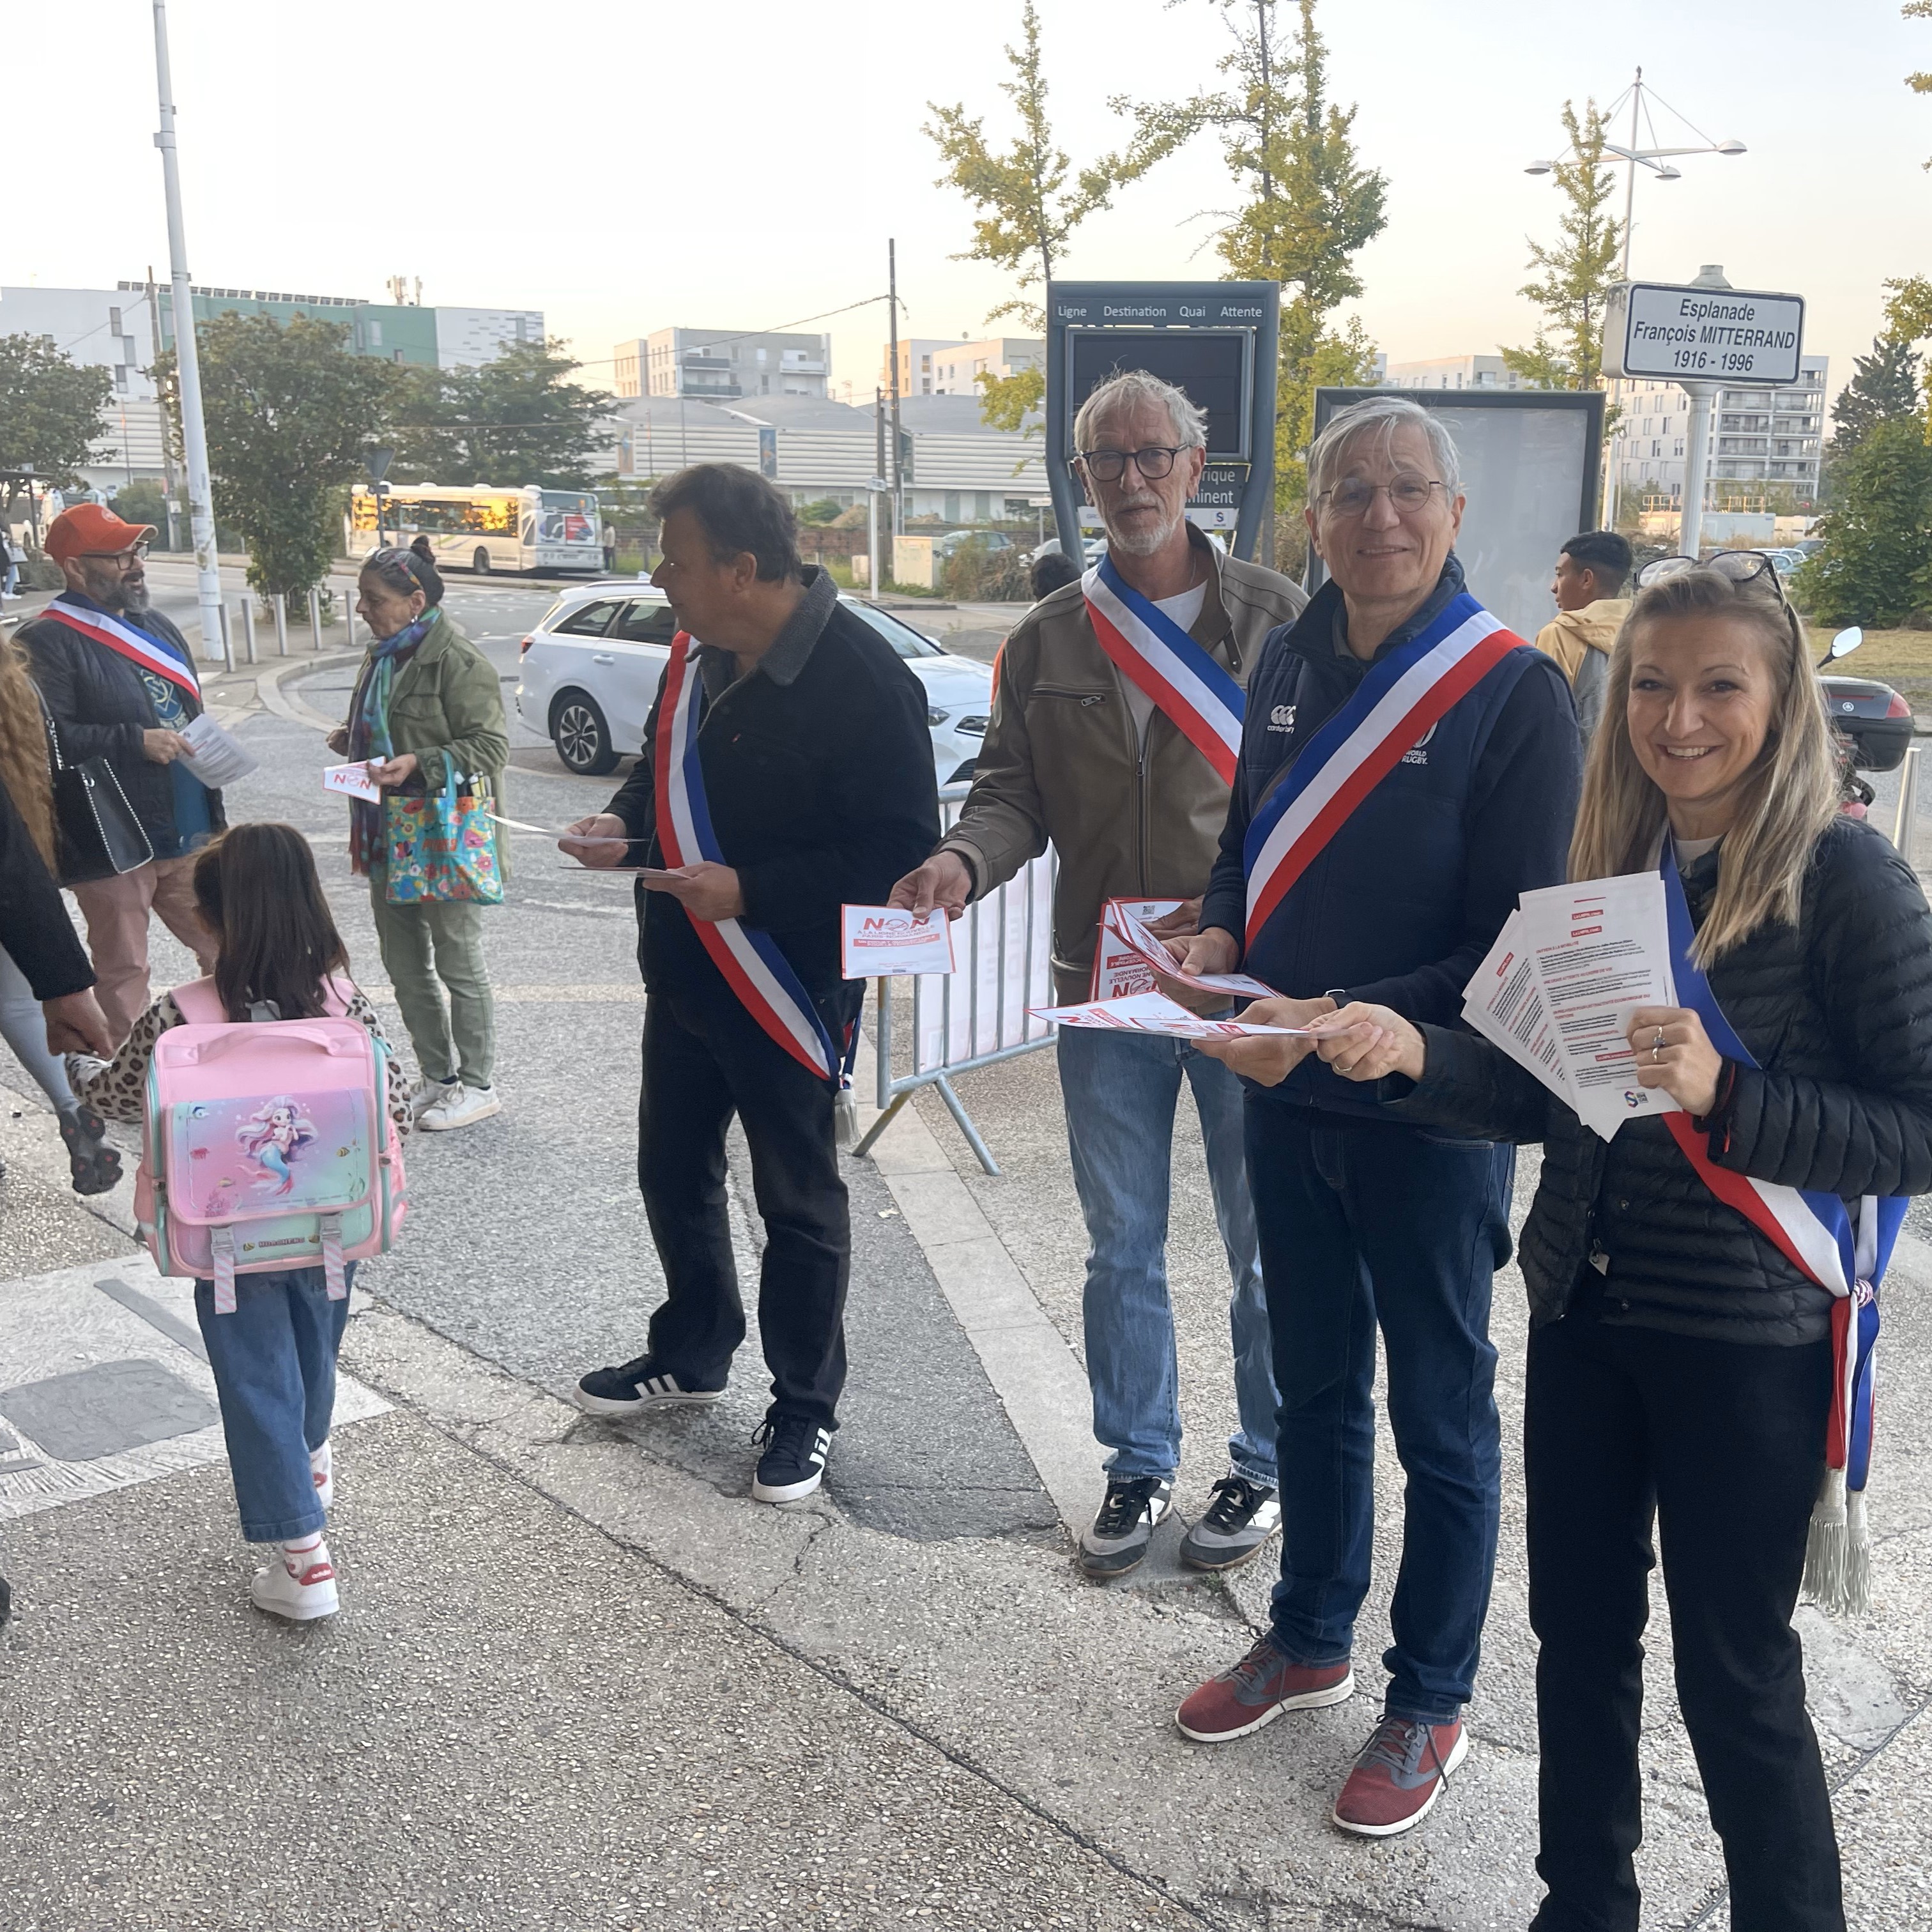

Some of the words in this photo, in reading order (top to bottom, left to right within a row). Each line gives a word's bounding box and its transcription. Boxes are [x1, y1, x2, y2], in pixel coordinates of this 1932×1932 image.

[1058, 306, 1087, 318] Ligne
[1103, 305, 1167, 317] Destination
[1179, 306, 1206, 318] Quai
[1220, 306, 1262, 318] Attente
[1680, 298, 1754, 322] Esplanade
[1634, 321, 1696, 346] François
[1699, 325, 1795, 349] MITTERRAND
[1675, 350, 1707, 369] 1916
[1721, 353, 1754, 371] 1996
[1202, 467, 1235, 485] rique
[1188, 489, 1234, 503] minent
[334, 774, 371, 790] NON
[864, 917, 930, 931] NON
